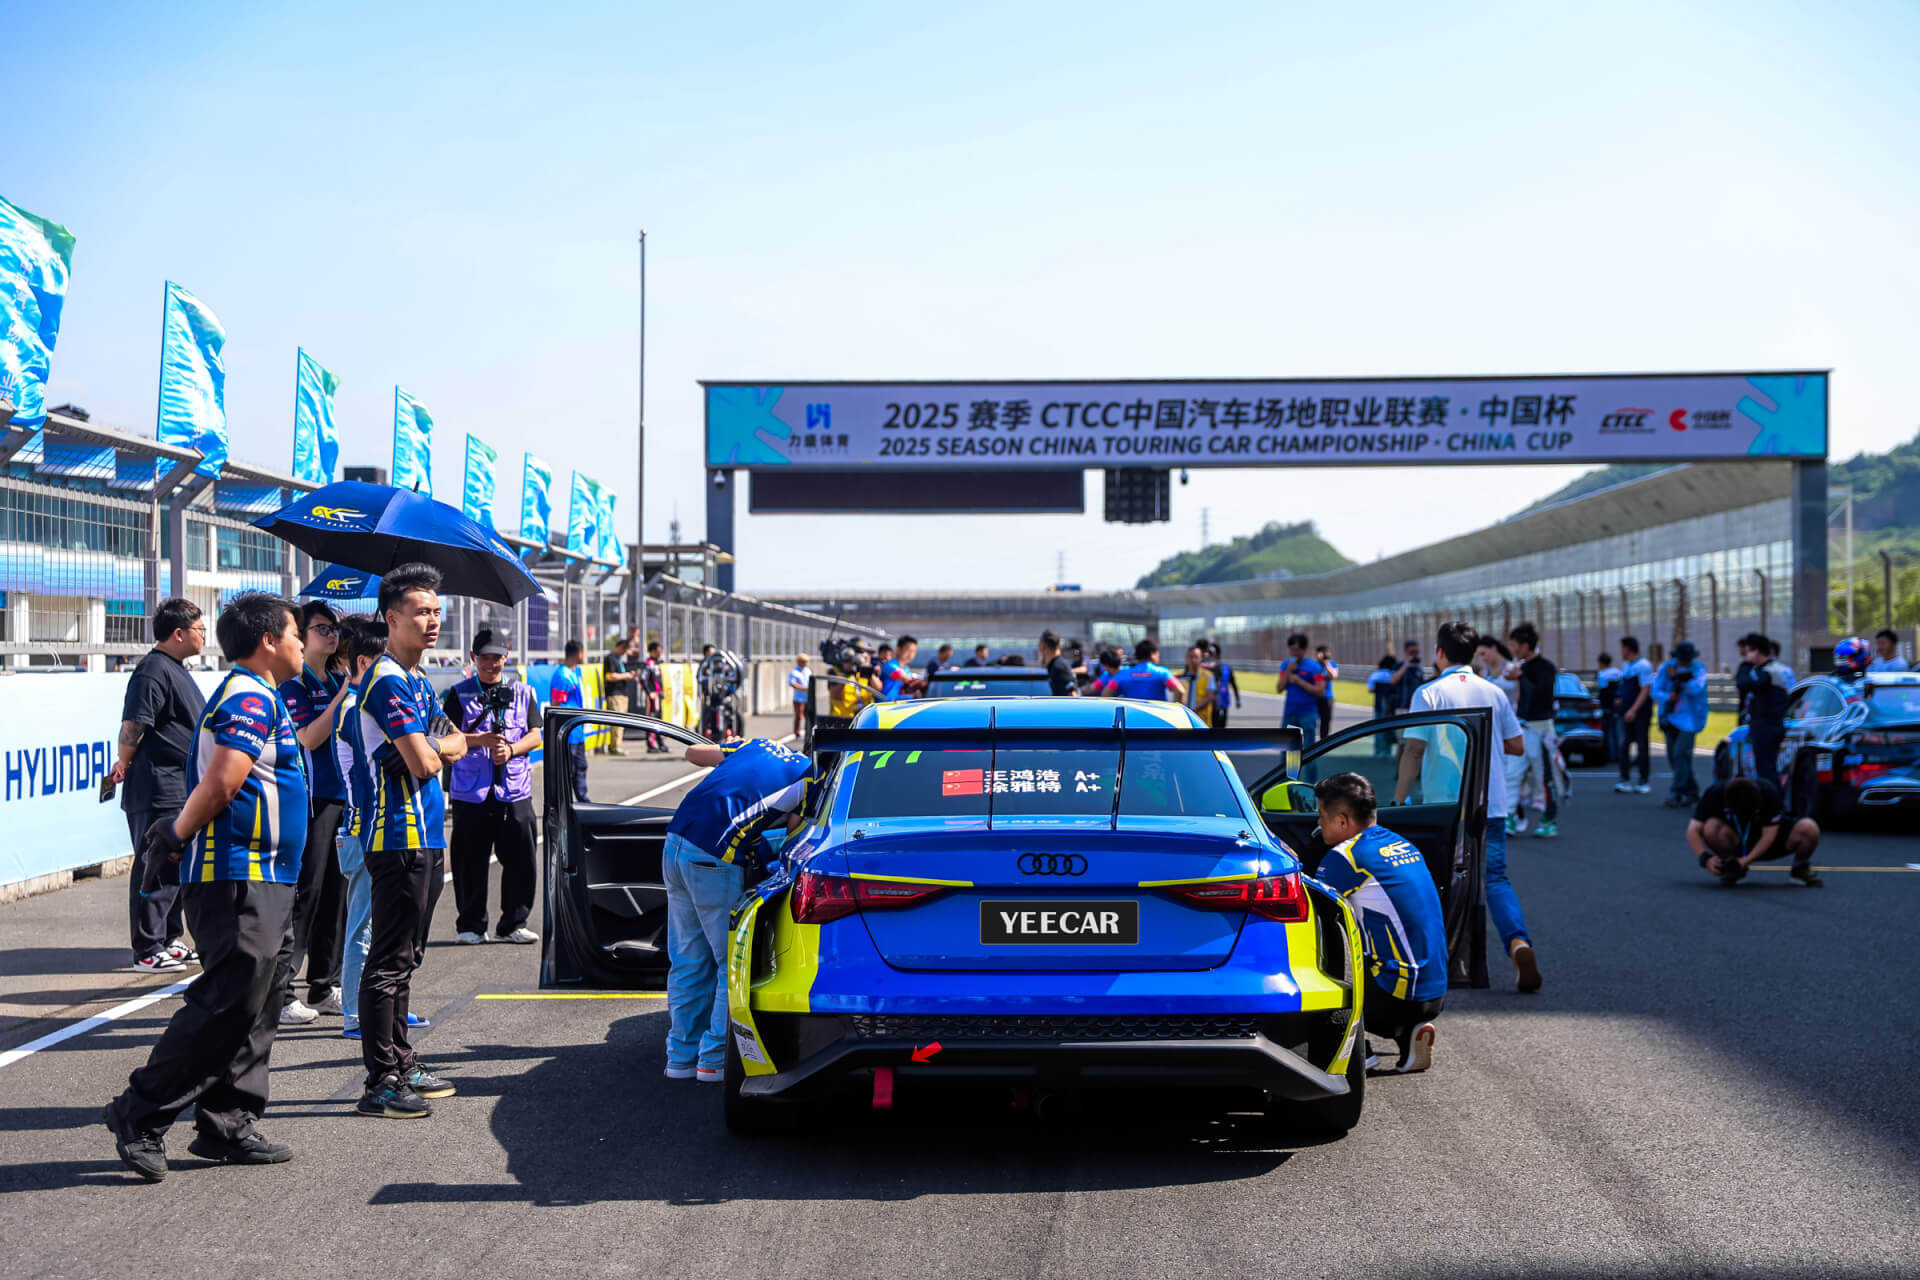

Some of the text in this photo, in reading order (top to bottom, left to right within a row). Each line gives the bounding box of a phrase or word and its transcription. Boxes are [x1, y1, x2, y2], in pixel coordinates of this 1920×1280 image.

[882, 403, 959, 429] 2025
[968, 400, 1032, 430] 赛季
[879, 438, 930, 456] 2025
[937, 437, 1023, 455] SEASON
[1029, 437, 1097, 455] CHINA
[1104, 437, 1202, 454] TOURING
[1208, 436, 1251, 454] CAR
[1256, 434, 1429, 454] CHAMPIONSHIP
[1447, 433, 1516, 452] CHINA
[1527, 431, 1573, 451] CUP
[5, 740, 111, 801] HYUNDAI
[1074, 770, 1101, 781] A+
[1076, 781, 1102, 793] A+
[1000, 911, 1120, 935] YEECAR
